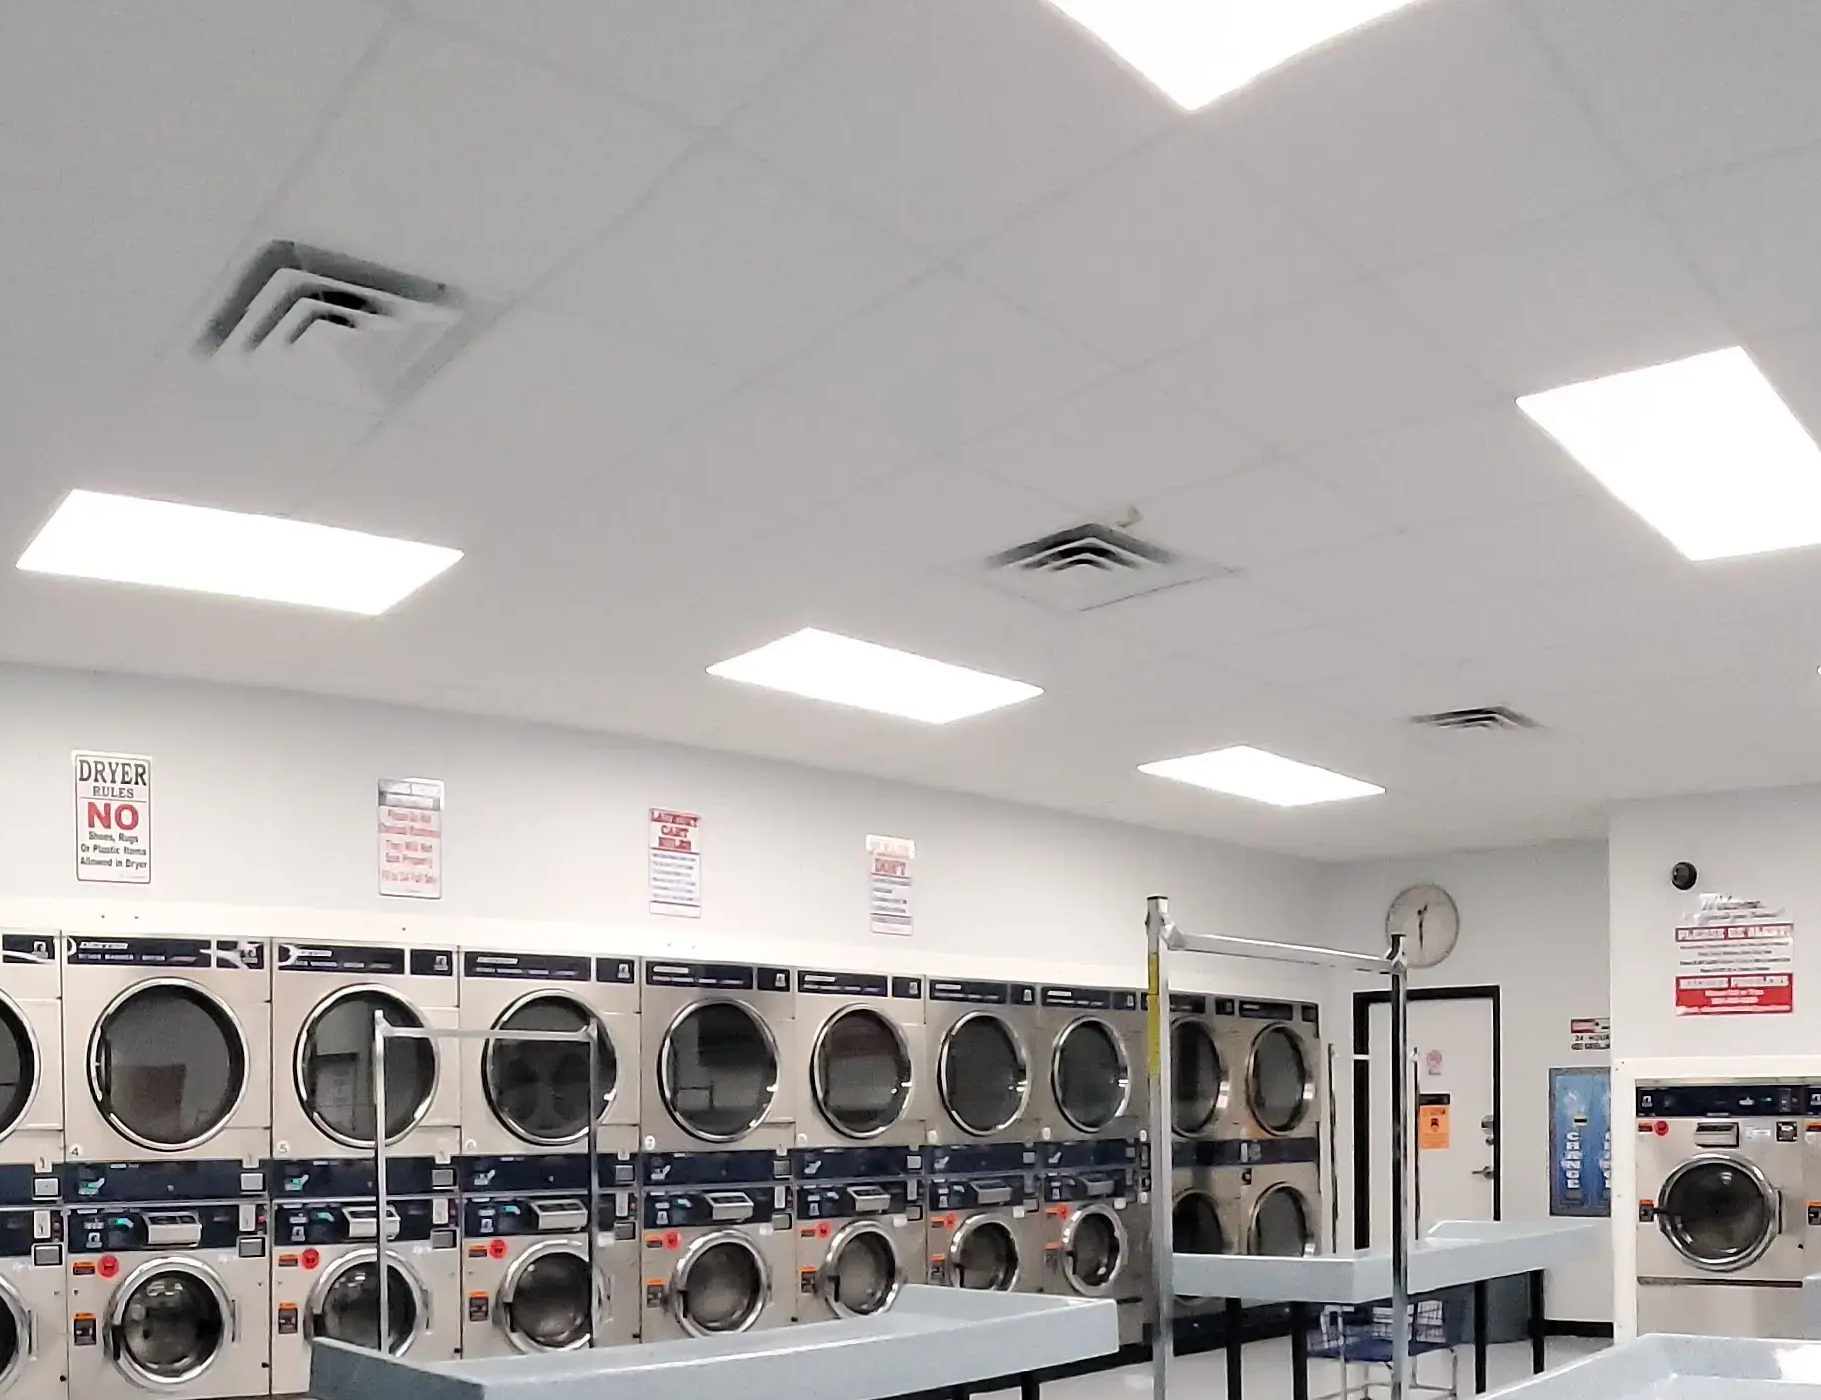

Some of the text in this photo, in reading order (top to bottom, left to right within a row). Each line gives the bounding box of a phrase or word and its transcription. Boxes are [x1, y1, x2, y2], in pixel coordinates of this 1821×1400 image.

[78, 759, 147, 786] DRYER
[92, 785, 134, 798] RULES
[87, 801, 139, 831] NO
